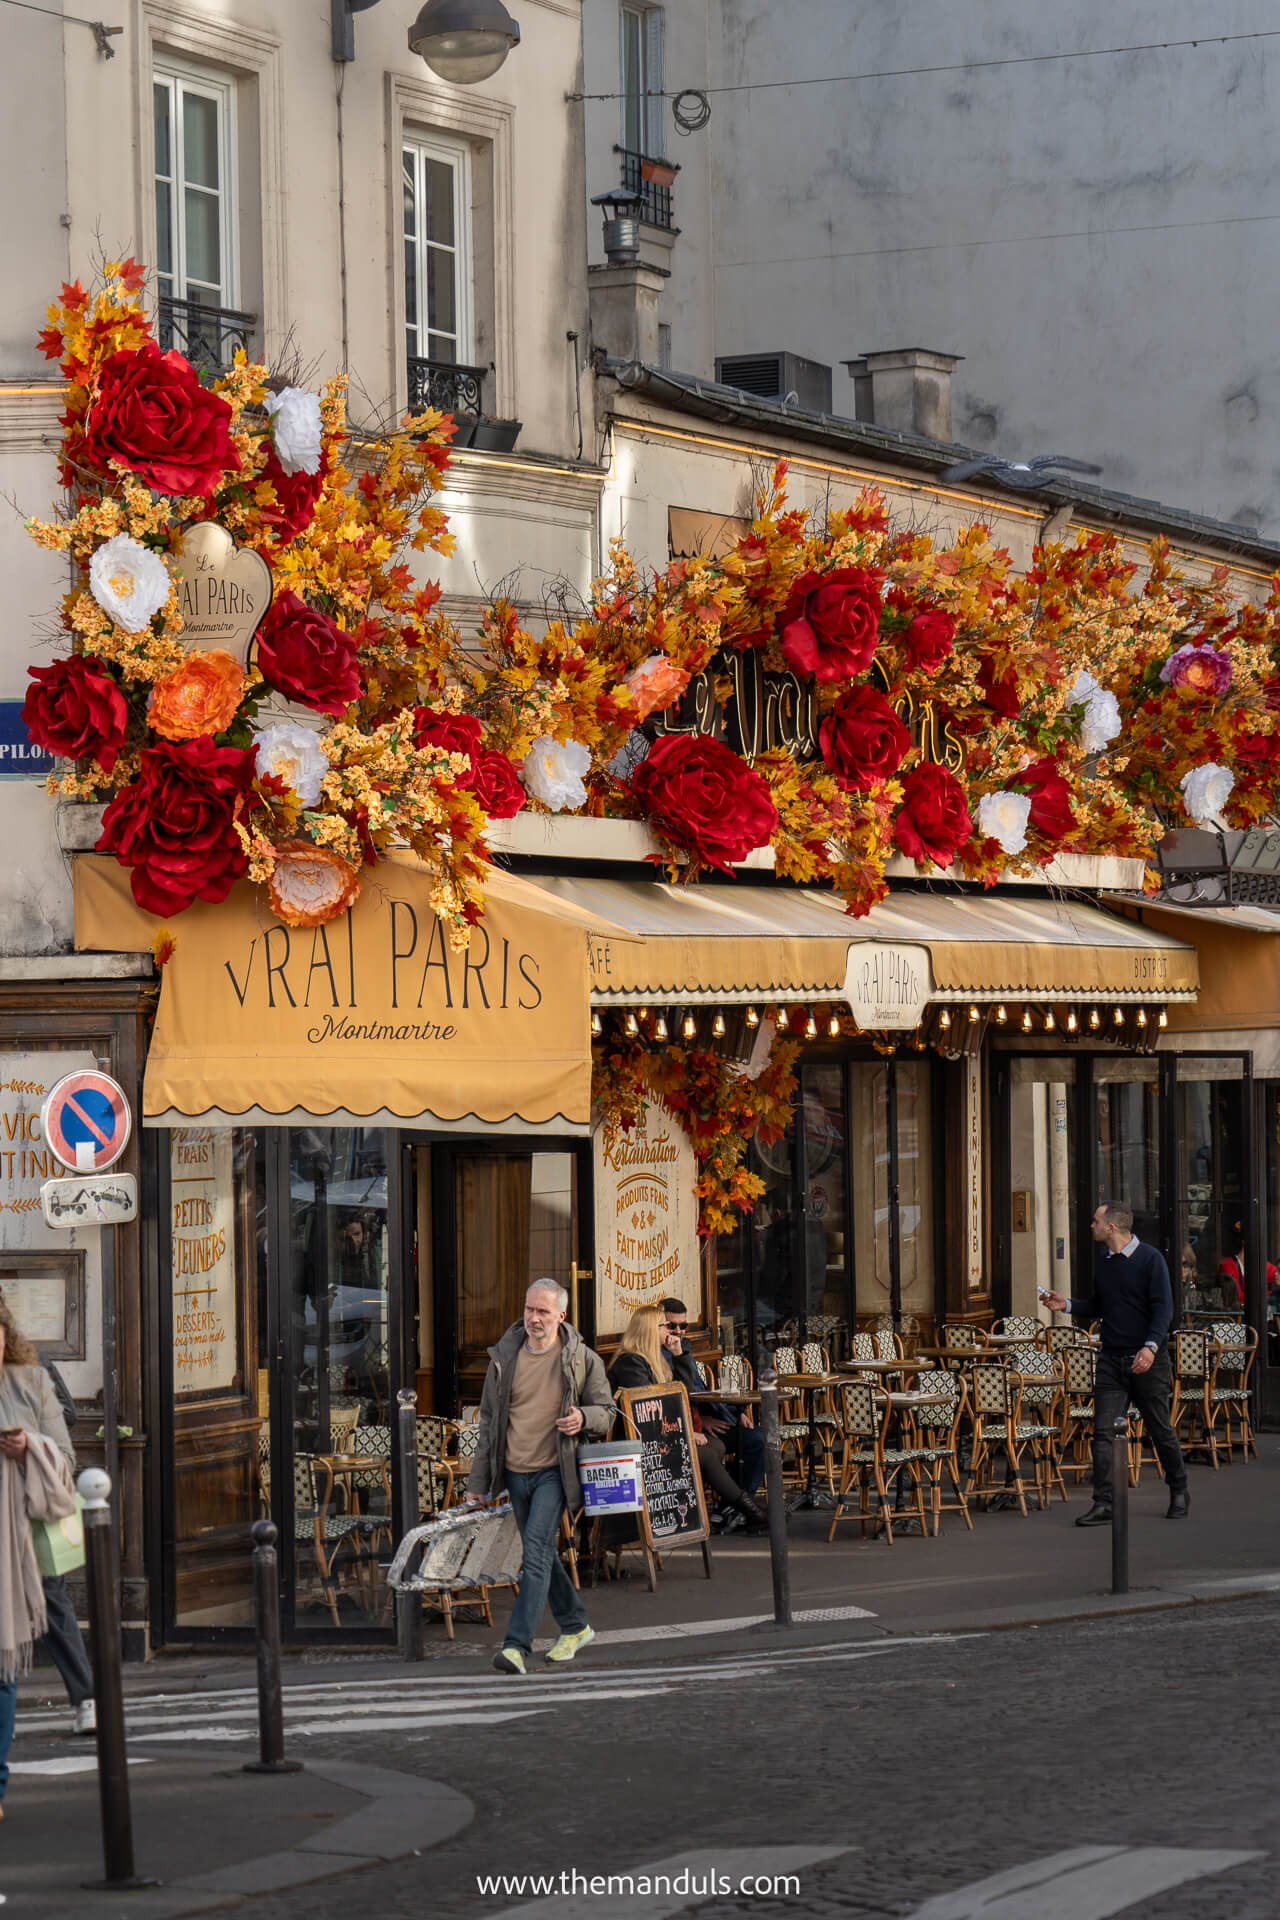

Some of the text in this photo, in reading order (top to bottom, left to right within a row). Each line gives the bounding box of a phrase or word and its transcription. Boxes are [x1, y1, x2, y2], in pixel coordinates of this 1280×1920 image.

[196, 554, 216, 572] Le
[175, 577, 254, 616] AI PARIS
[177, 620, 234, 635] Montmartre
[224, 901, 542, 1010] VRAI PARIS
[589, 942, 612, 975] AFÉ
[1134, 957, 1167, 978] BISTROT
[857, 951, 919, 1006] VRAI PARIS
[307, 1014, 458, 1044] Montmartre
[0, 1112, 41, 1142] VIC
[0, 1149, 66, 1179] TINU
[177, 1144, 209, 1164] FRAIS
[971, 1076, 979, 1253] BIENVENUE
[174, 1197, 214, 1228] PETITS
[616, 1185, 669, 1217] PRODUITS FRAIS
[639, 1209, 646, 1229] &
[616, 1224, 669, 1260] FAIT MAISON
[614, 1262, 648, 1290] TOUTE
[649, 1247, 680, 1288] HEURE
[173, 1327, 225, 1346] ourmands
[635, 1400, 663, 1424] HAPPY
[586, 1467, 619, 1482] BAGAR
